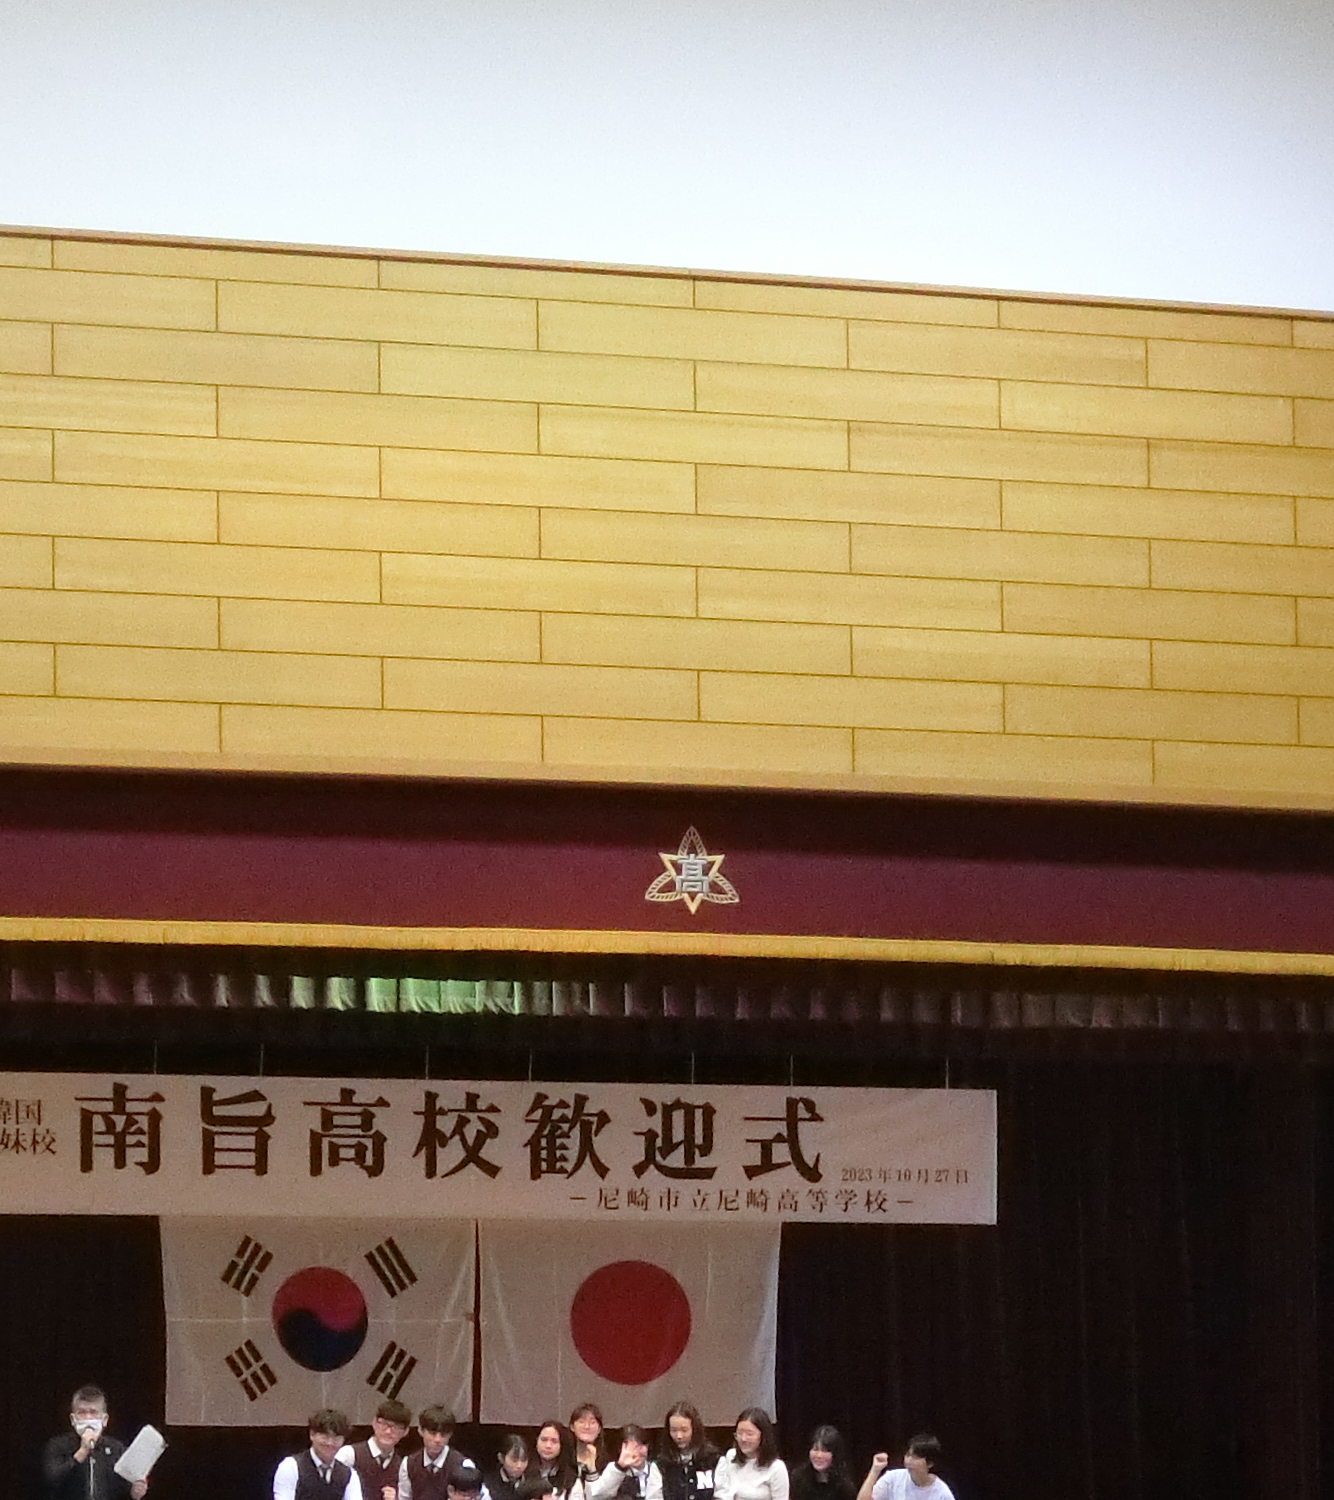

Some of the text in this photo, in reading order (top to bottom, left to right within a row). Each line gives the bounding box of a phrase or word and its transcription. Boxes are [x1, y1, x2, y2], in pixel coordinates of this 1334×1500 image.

[74, 1081, 825, 1184] 南旨高校歓迎式
[696, 1470, 713, 1490] N
